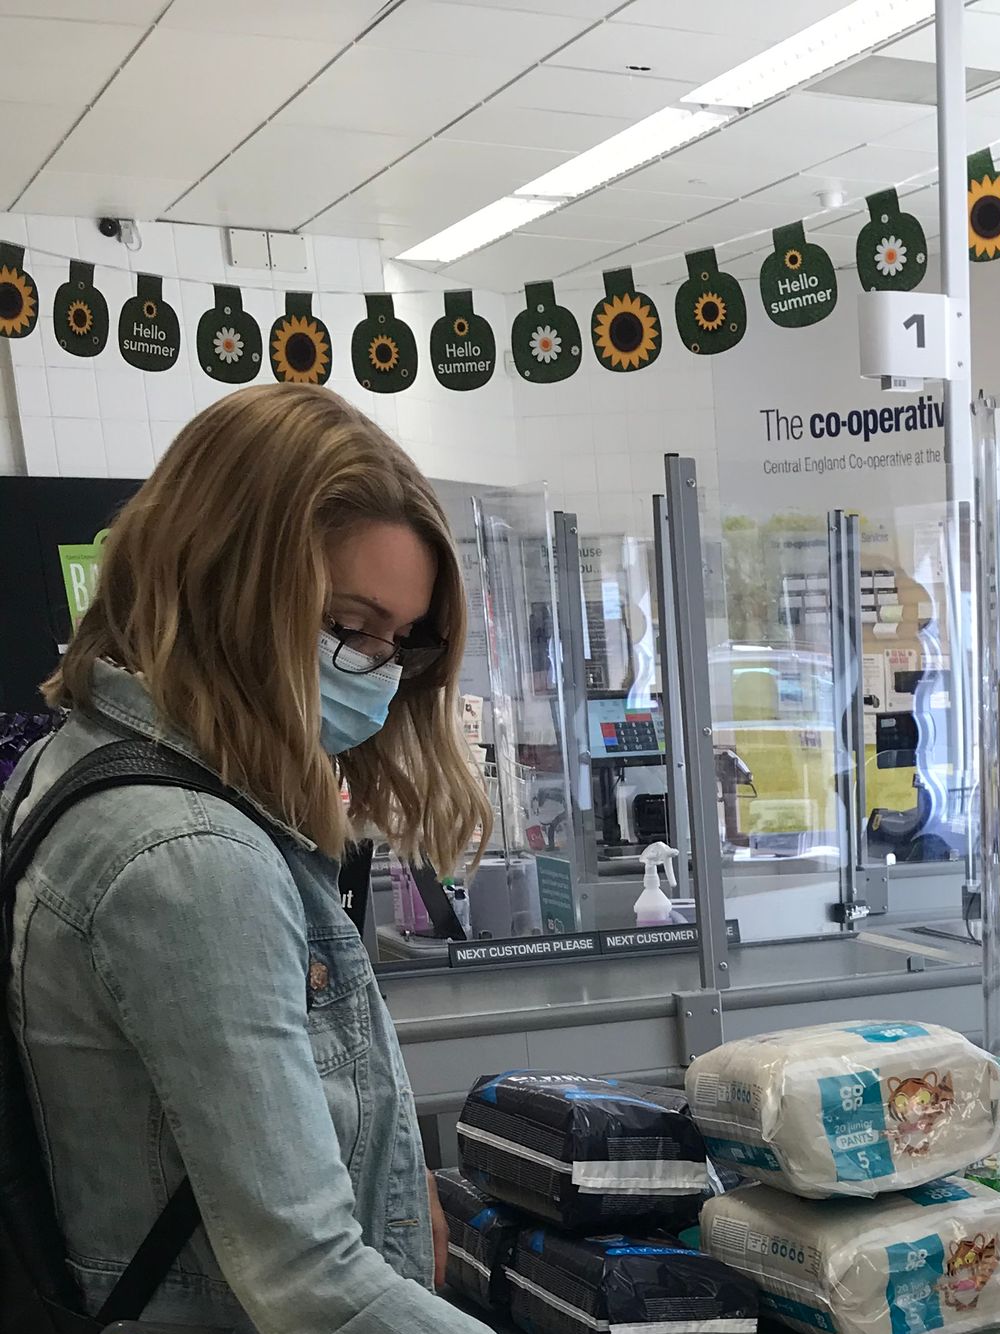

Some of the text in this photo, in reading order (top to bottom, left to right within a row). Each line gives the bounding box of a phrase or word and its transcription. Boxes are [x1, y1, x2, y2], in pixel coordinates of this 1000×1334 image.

[778, 272, 819, 296] Hello
[770, 288, 832, 314] summer
[133, 322, 167, 341] Hello
[902, 313, 926, 349] 1
[123, 339, 176, 358] summer
[445, 341, 481, 358] Hello
[437, 360, 491, 375] summer
[760, 408, 804, 441] The
[808, 395, 946, 442] co-operativ
[763, 458, 801, 475] Central
[804, 454, 846, 475] England
[849, 450, 913, 470] Co-operative
[914, 450, 924, 465] at
[925, 447, 941, 463] the
[606, 934, 634, 948] NEXT
[636, 929, 694, 945] CUSTOMER
[456, 938, 594, 961] NEXT CUSTOMER PLEASE
[833, 1125, 846, 1135] 20
[840, 1130, 874, 1147] PANTS
[856, 1151, 870, 1169] 5
